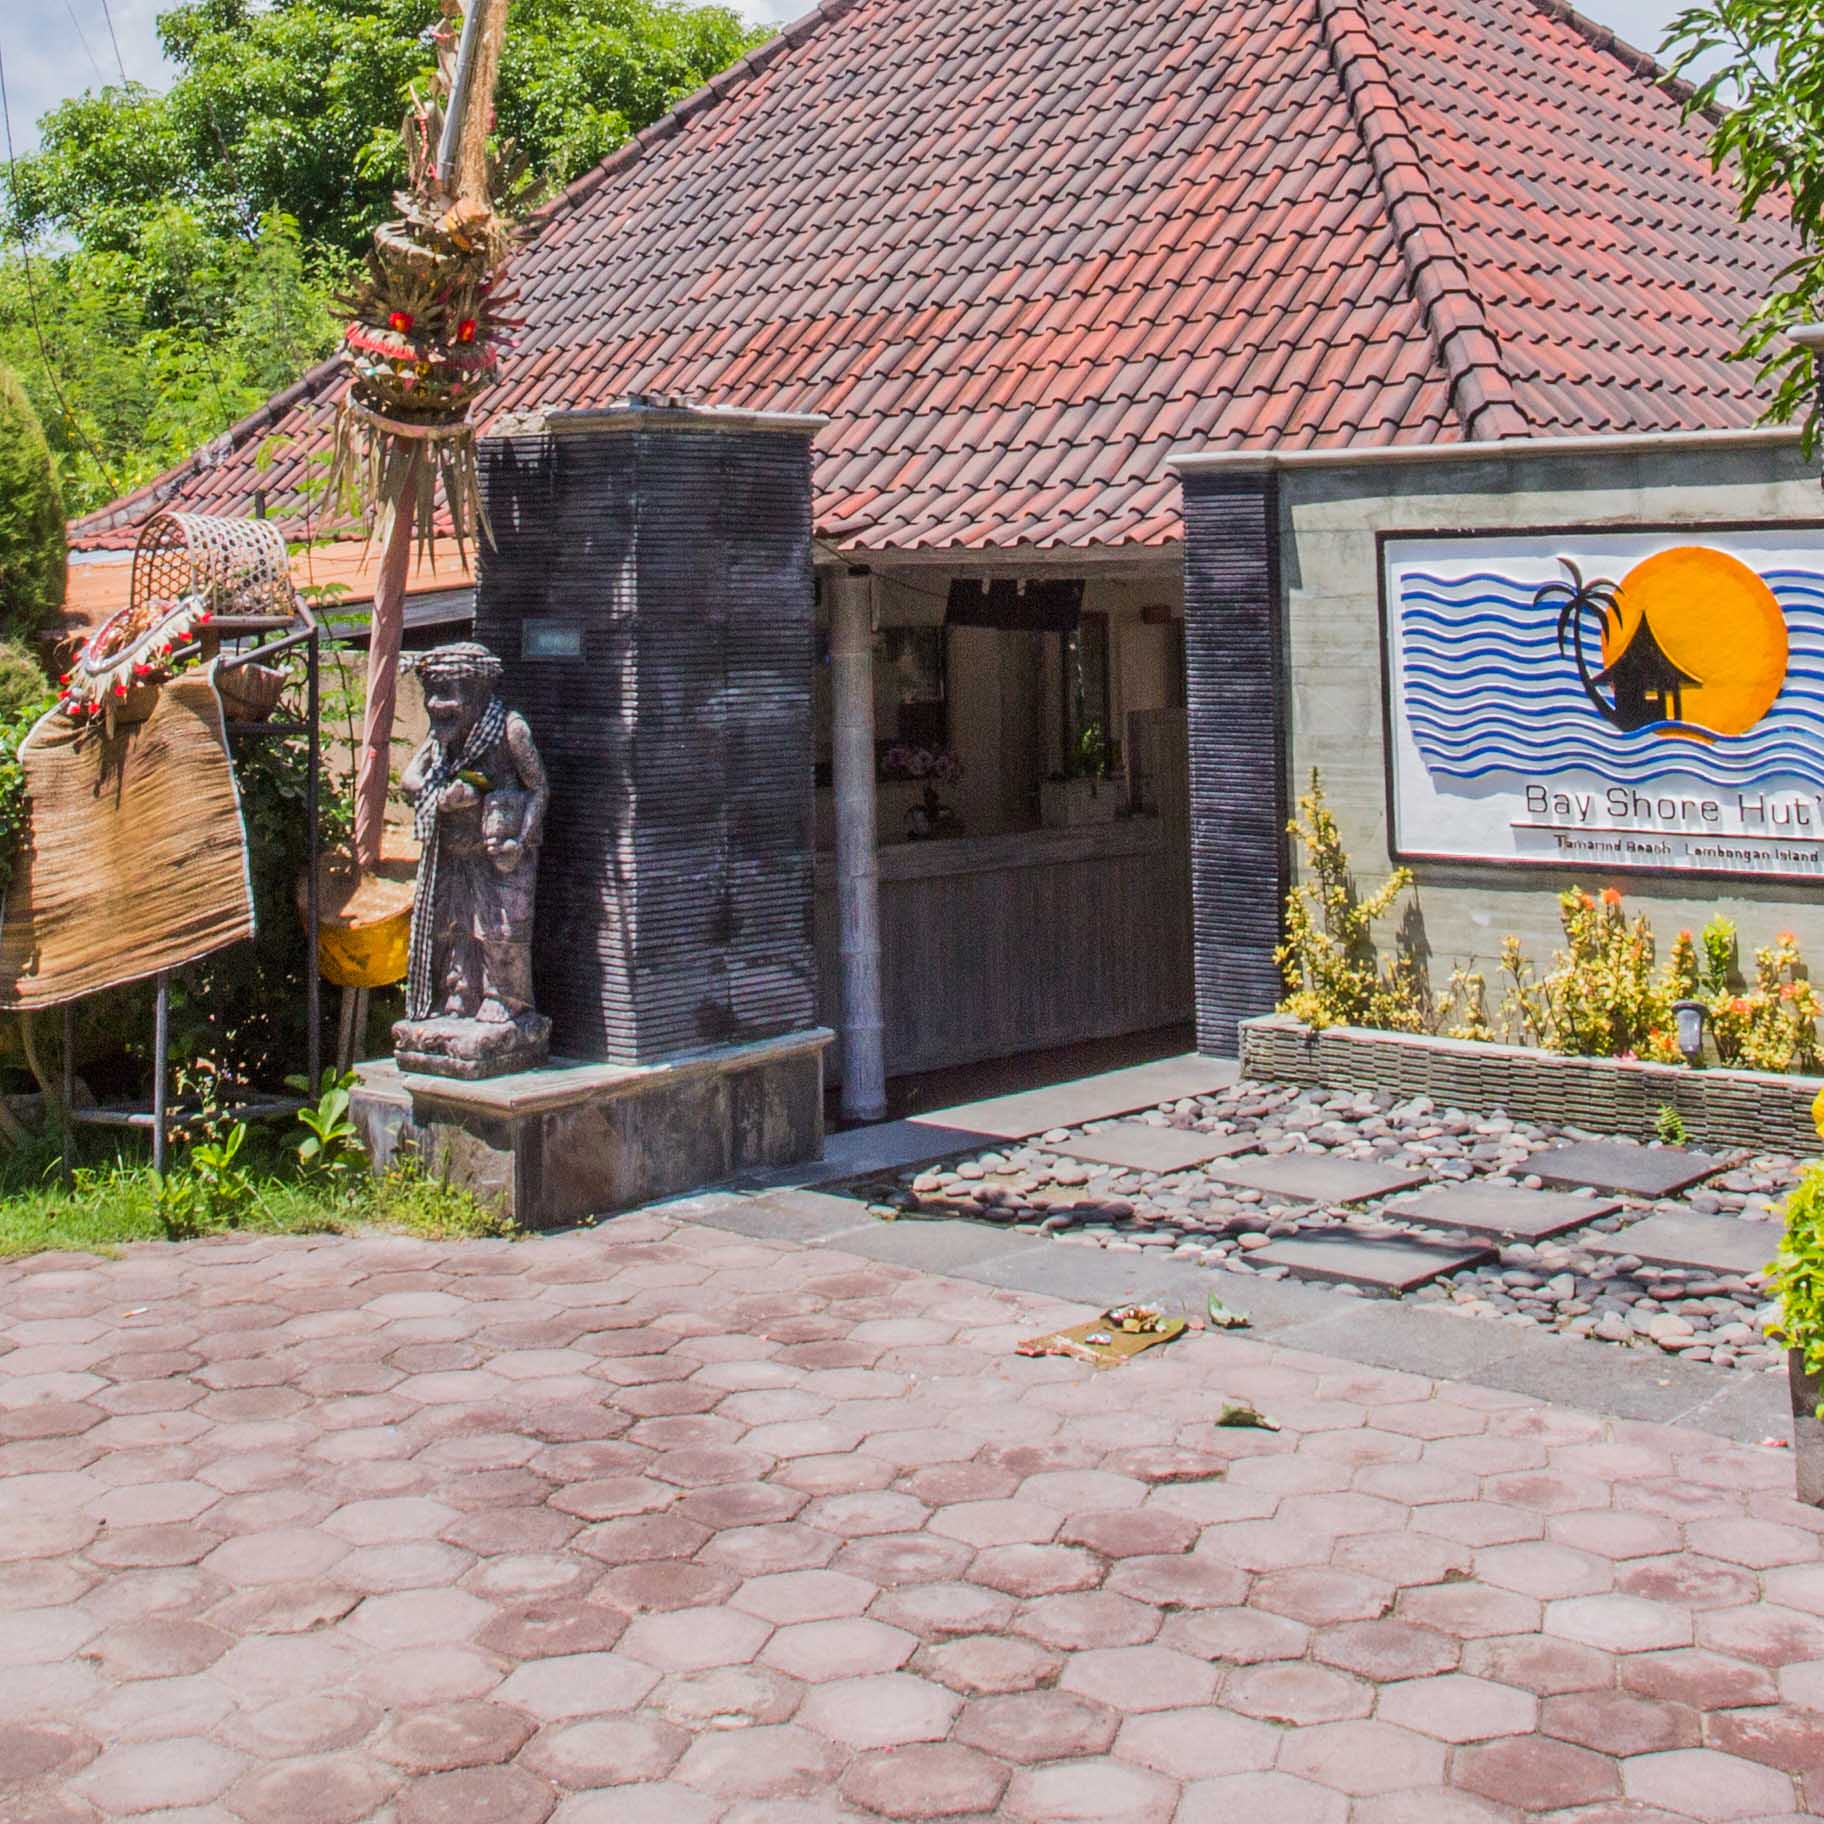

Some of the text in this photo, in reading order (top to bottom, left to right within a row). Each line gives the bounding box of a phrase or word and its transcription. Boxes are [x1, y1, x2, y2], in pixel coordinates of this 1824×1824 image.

[1525, 784, 1590, 822] Bay
[1606, 787, 1719, 822] Shore
[1553, 833, 1622, 852] Tamarind
[1626, 840, 1671, 855] Beach
[1775, 848, 1819, 863] Island
